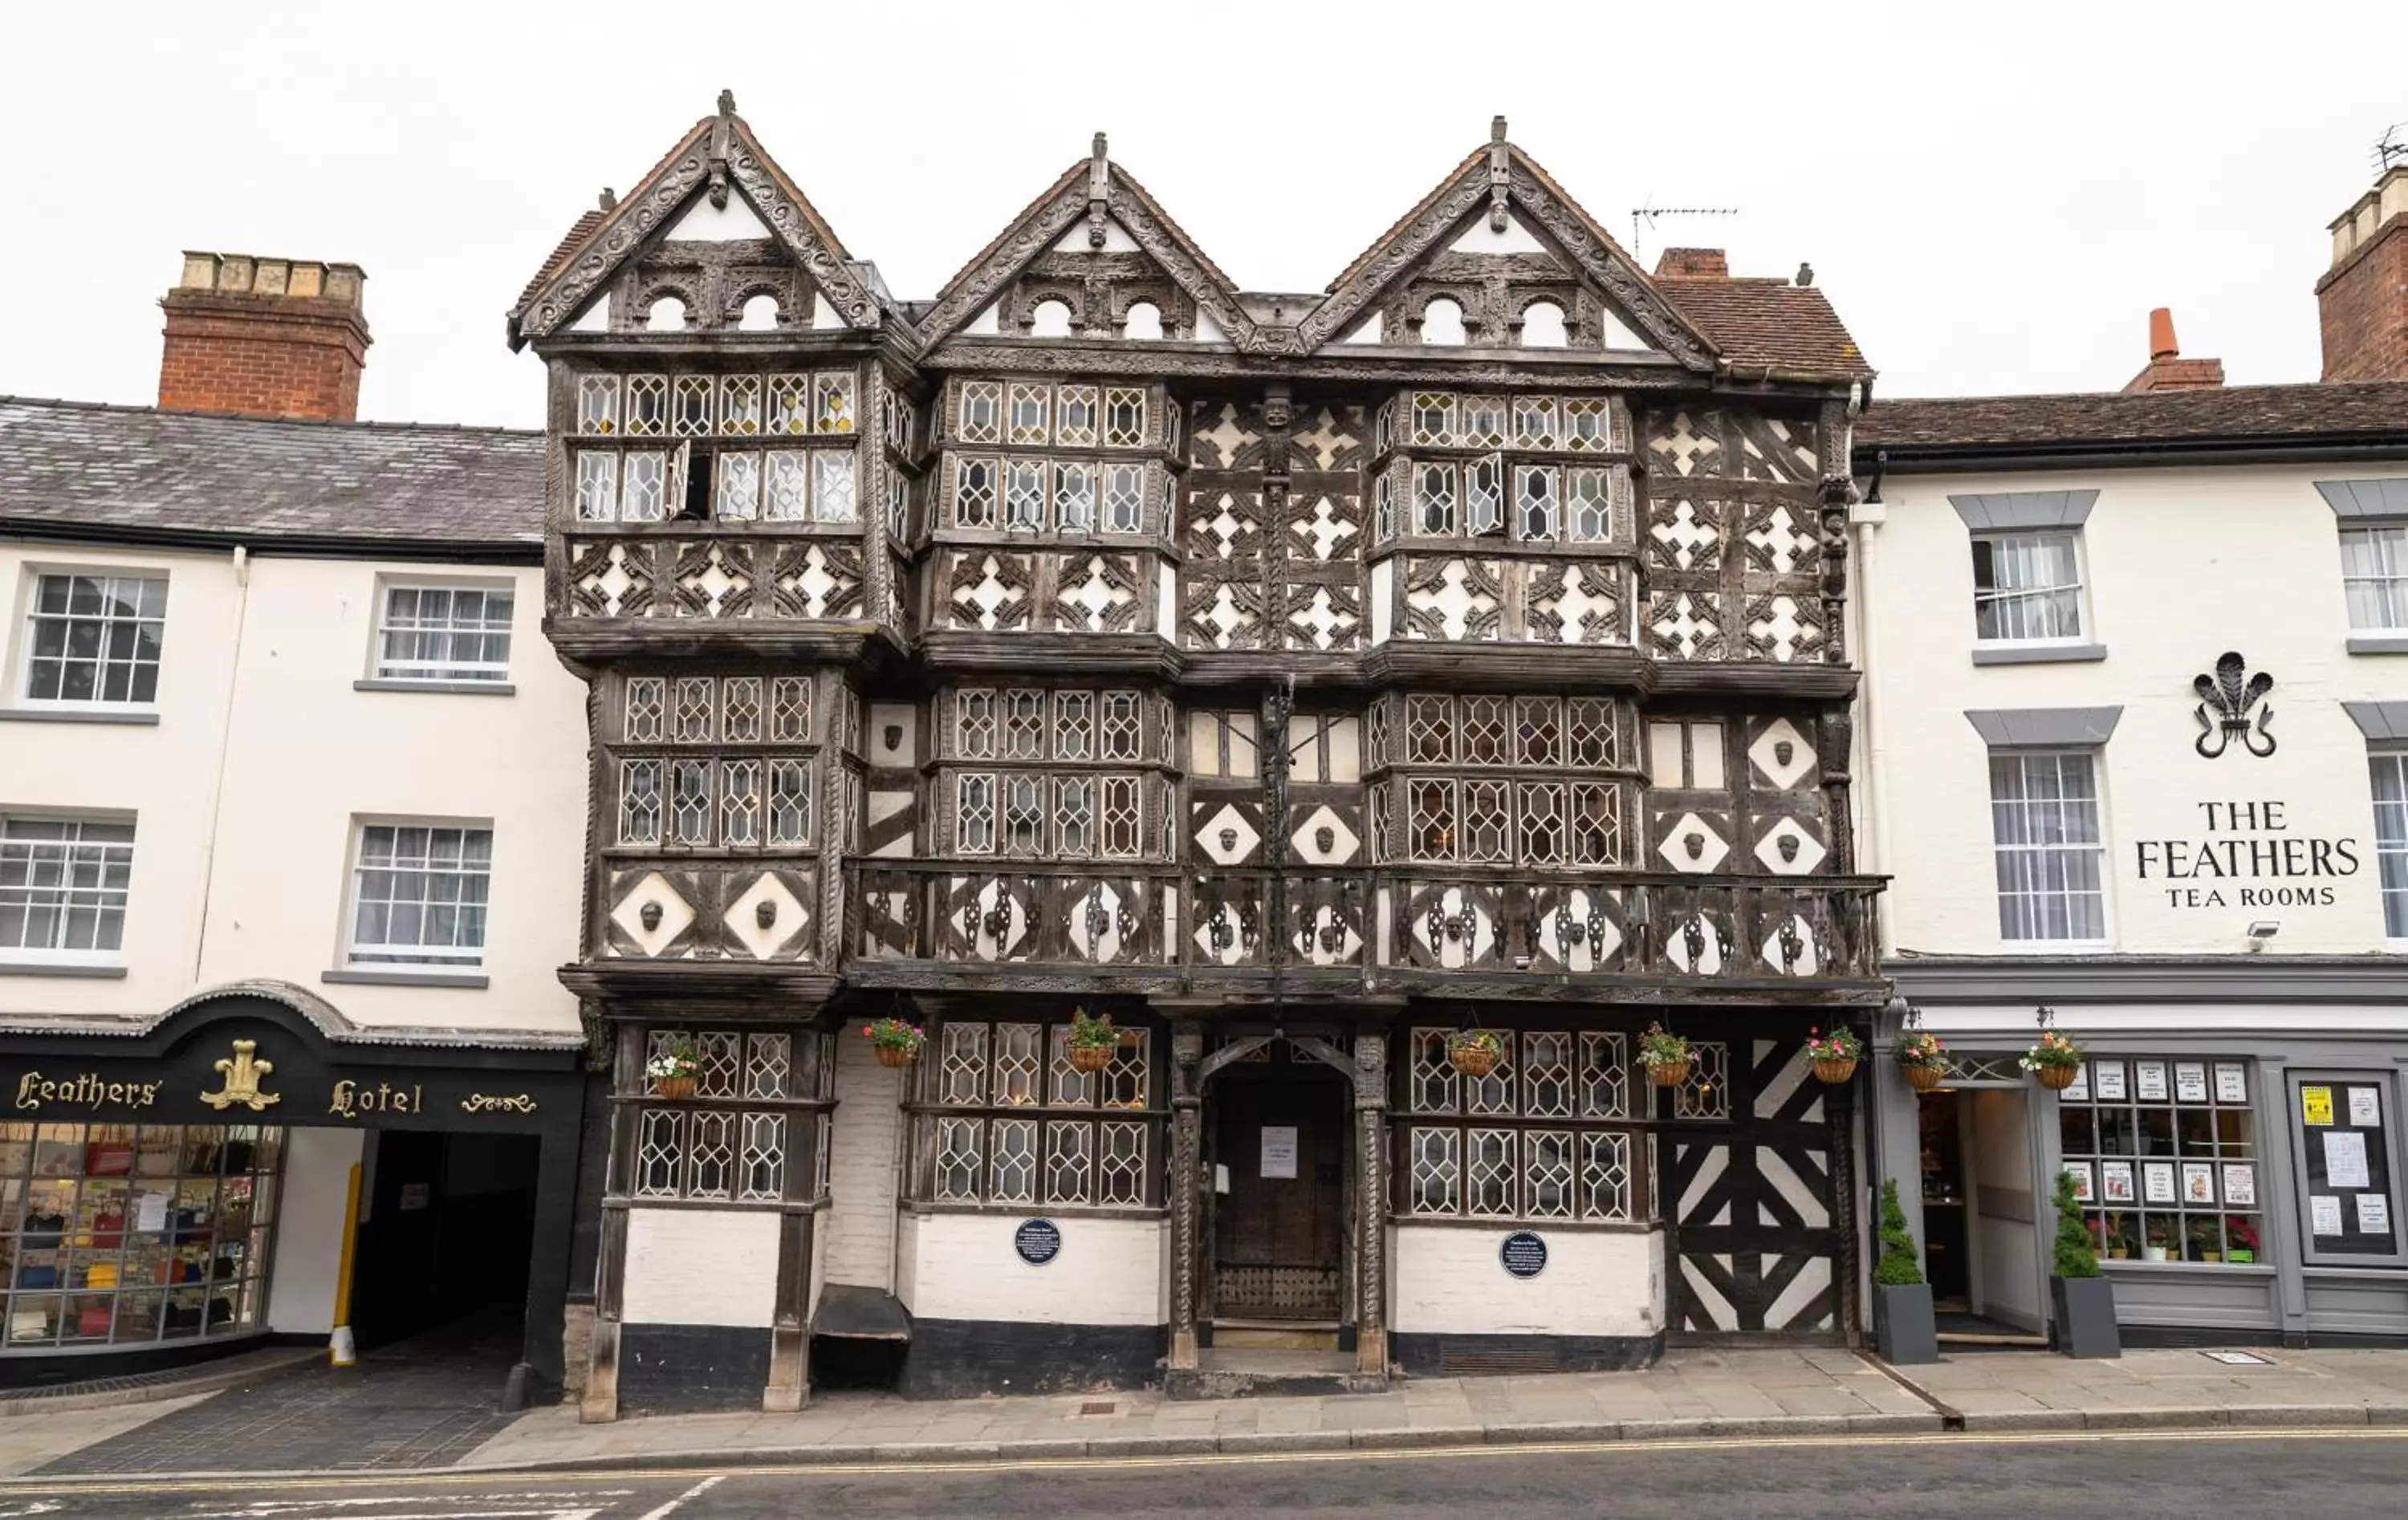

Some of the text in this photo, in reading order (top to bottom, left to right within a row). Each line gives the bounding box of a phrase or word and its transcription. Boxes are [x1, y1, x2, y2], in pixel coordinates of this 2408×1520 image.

[2198, 801, 2287, 831] THE
[2135, 838, 2359, 878] FEATHERS
[2165, 887, 2335, 908] TEA ROOMS
[15, 1071, 421, 1118] Feathers Hotel
